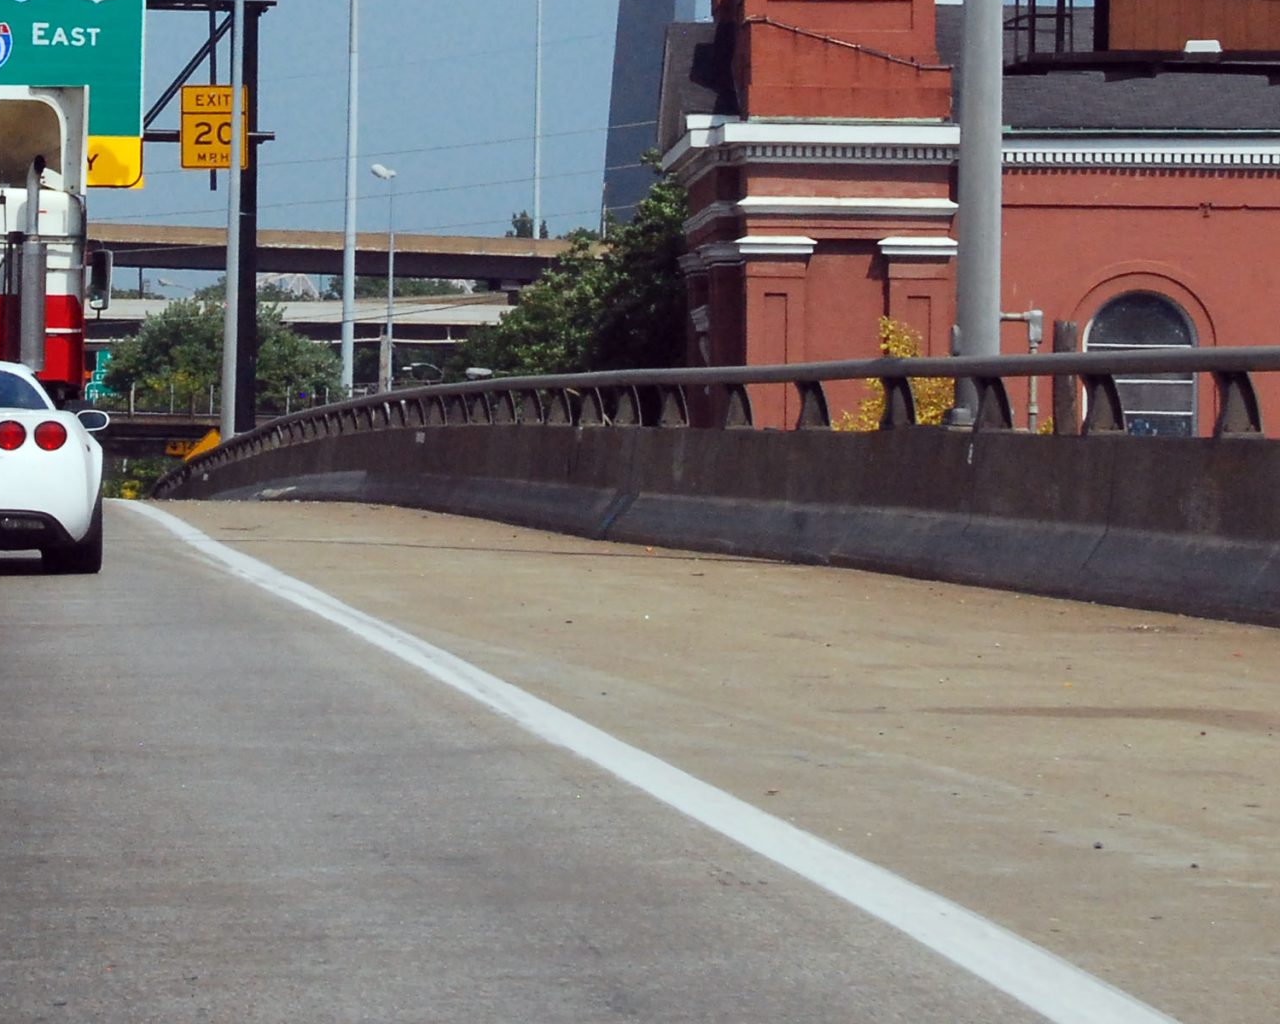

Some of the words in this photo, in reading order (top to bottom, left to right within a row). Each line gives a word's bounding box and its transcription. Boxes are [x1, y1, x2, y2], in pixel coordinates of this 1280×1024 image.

[32, 23, 101, 47] EAST
[195, 94, 231, 107] EXIT
[197, 152, 230, 162] MPH
